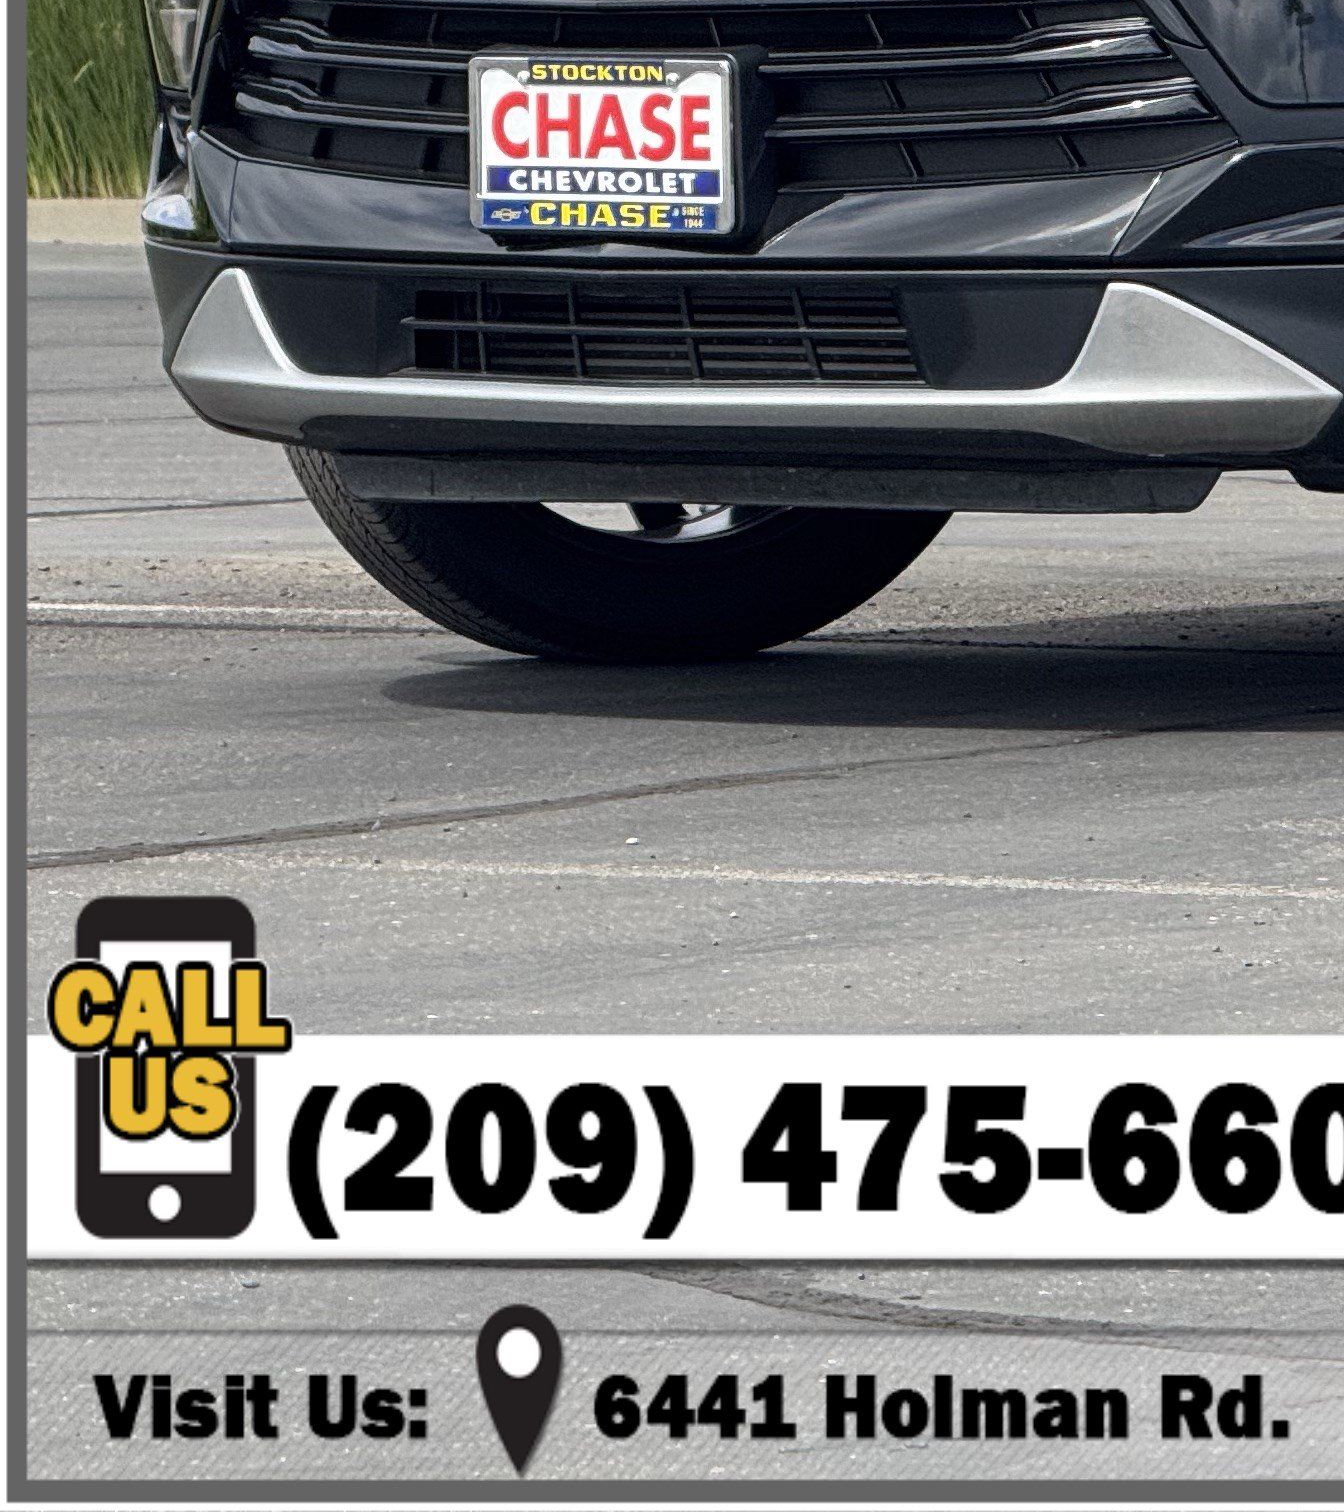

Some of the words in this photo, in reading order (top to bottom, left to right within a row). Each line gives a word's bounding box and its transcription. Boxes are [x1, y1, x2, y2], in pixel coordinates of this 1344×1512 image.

[531, 64, 663, 82] STOCKTON
[491, 91, 712, 161] CHASE
[508, 169, 697, 194] CHEVROLET
[530, 202, 671, 229] CHASE
